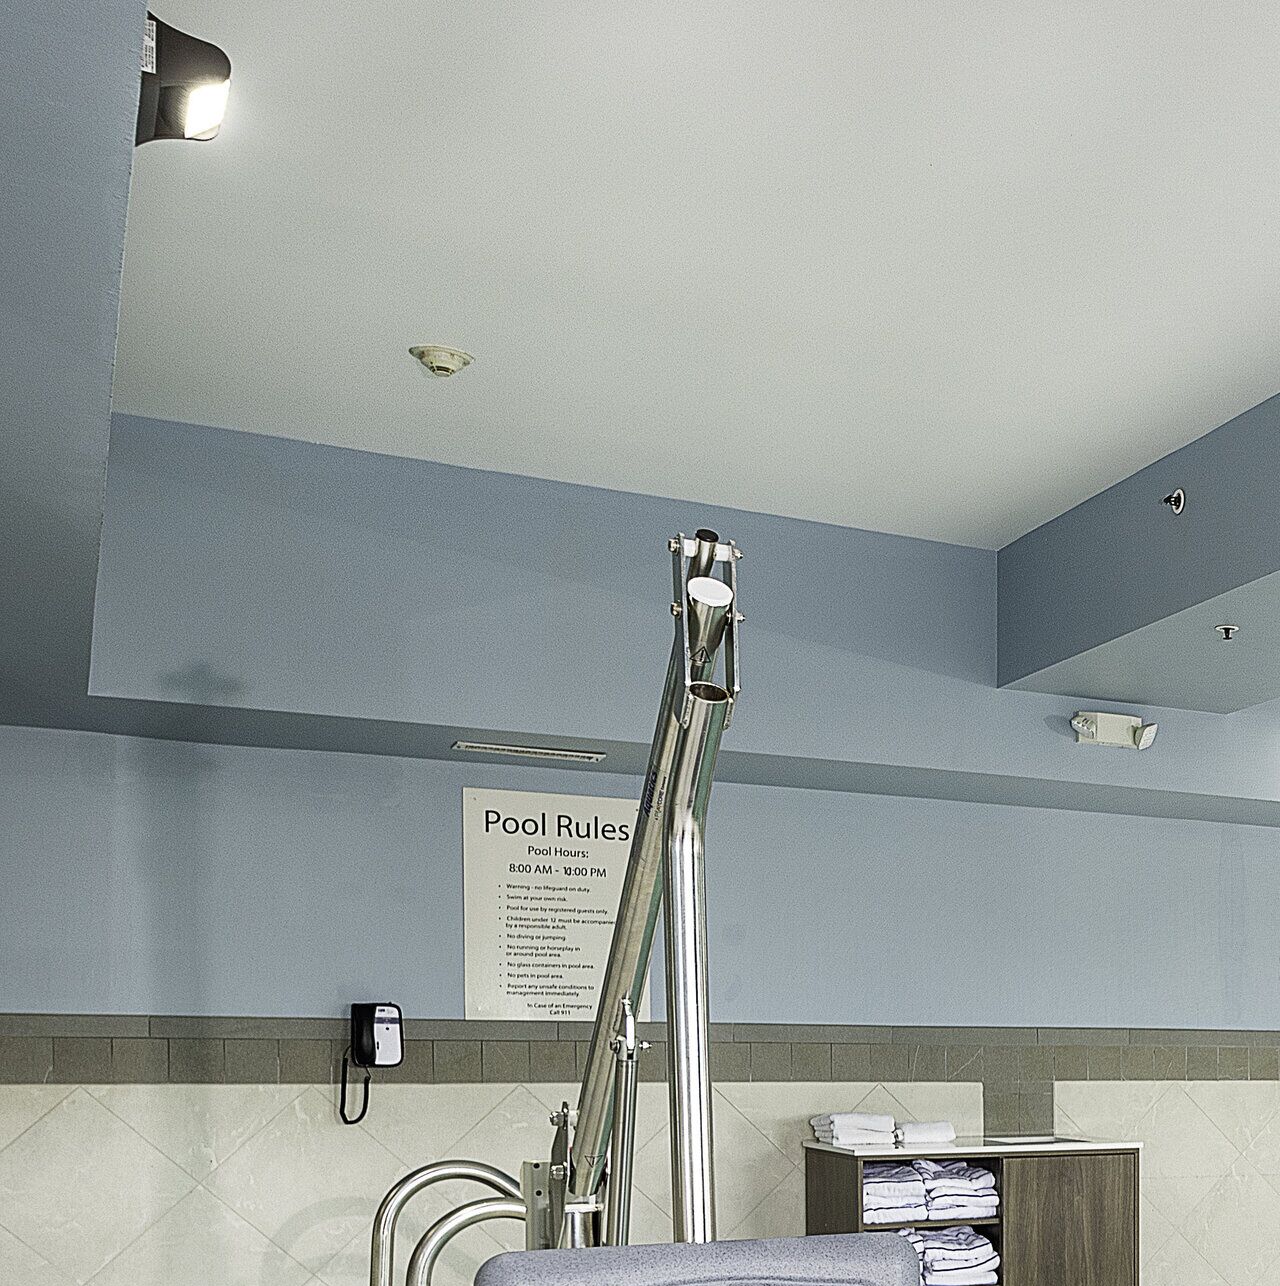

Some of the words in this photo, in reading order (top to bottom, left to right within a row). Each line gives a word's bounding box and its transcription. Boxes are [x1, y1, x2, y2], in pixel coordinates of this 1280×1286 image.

[643, 771, 658, 818] Aquatics
[484, 809, 546, 836] Pool
[557, 814, 630, 841] Rules
[527, 845, 552, 857] Pool
[554, 847, 589, 859] Hours:
[509, 863, 532, 874] 8:00
[534, 864, 553, 875] AM
[590, 868, 607, 878] PM
